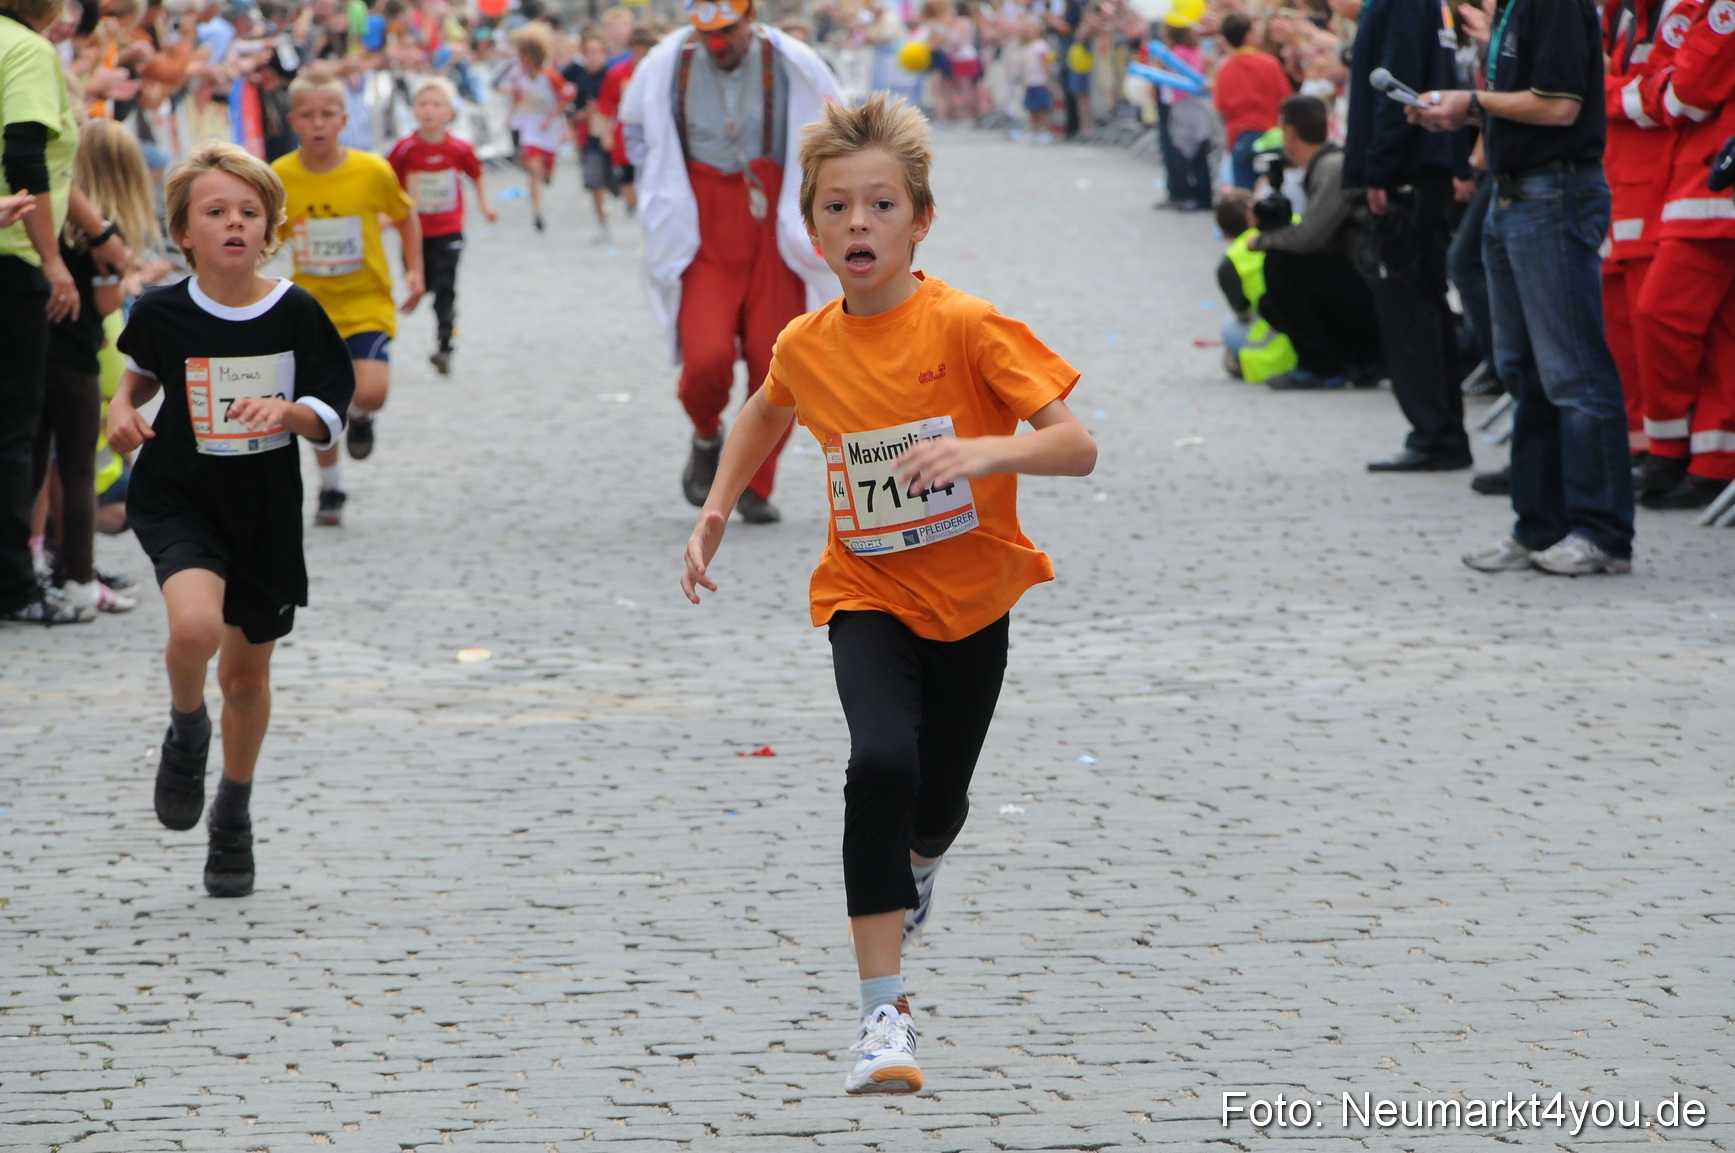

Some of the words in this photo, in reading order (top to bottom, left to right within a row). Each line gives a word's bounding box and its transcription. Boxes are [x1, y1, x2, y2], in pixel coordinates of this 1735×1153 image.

[848, 432, 943, 465] Maximil
[832, 480, 845, 498] K4
[918, 511, 975, 537] PFLEIDERER
